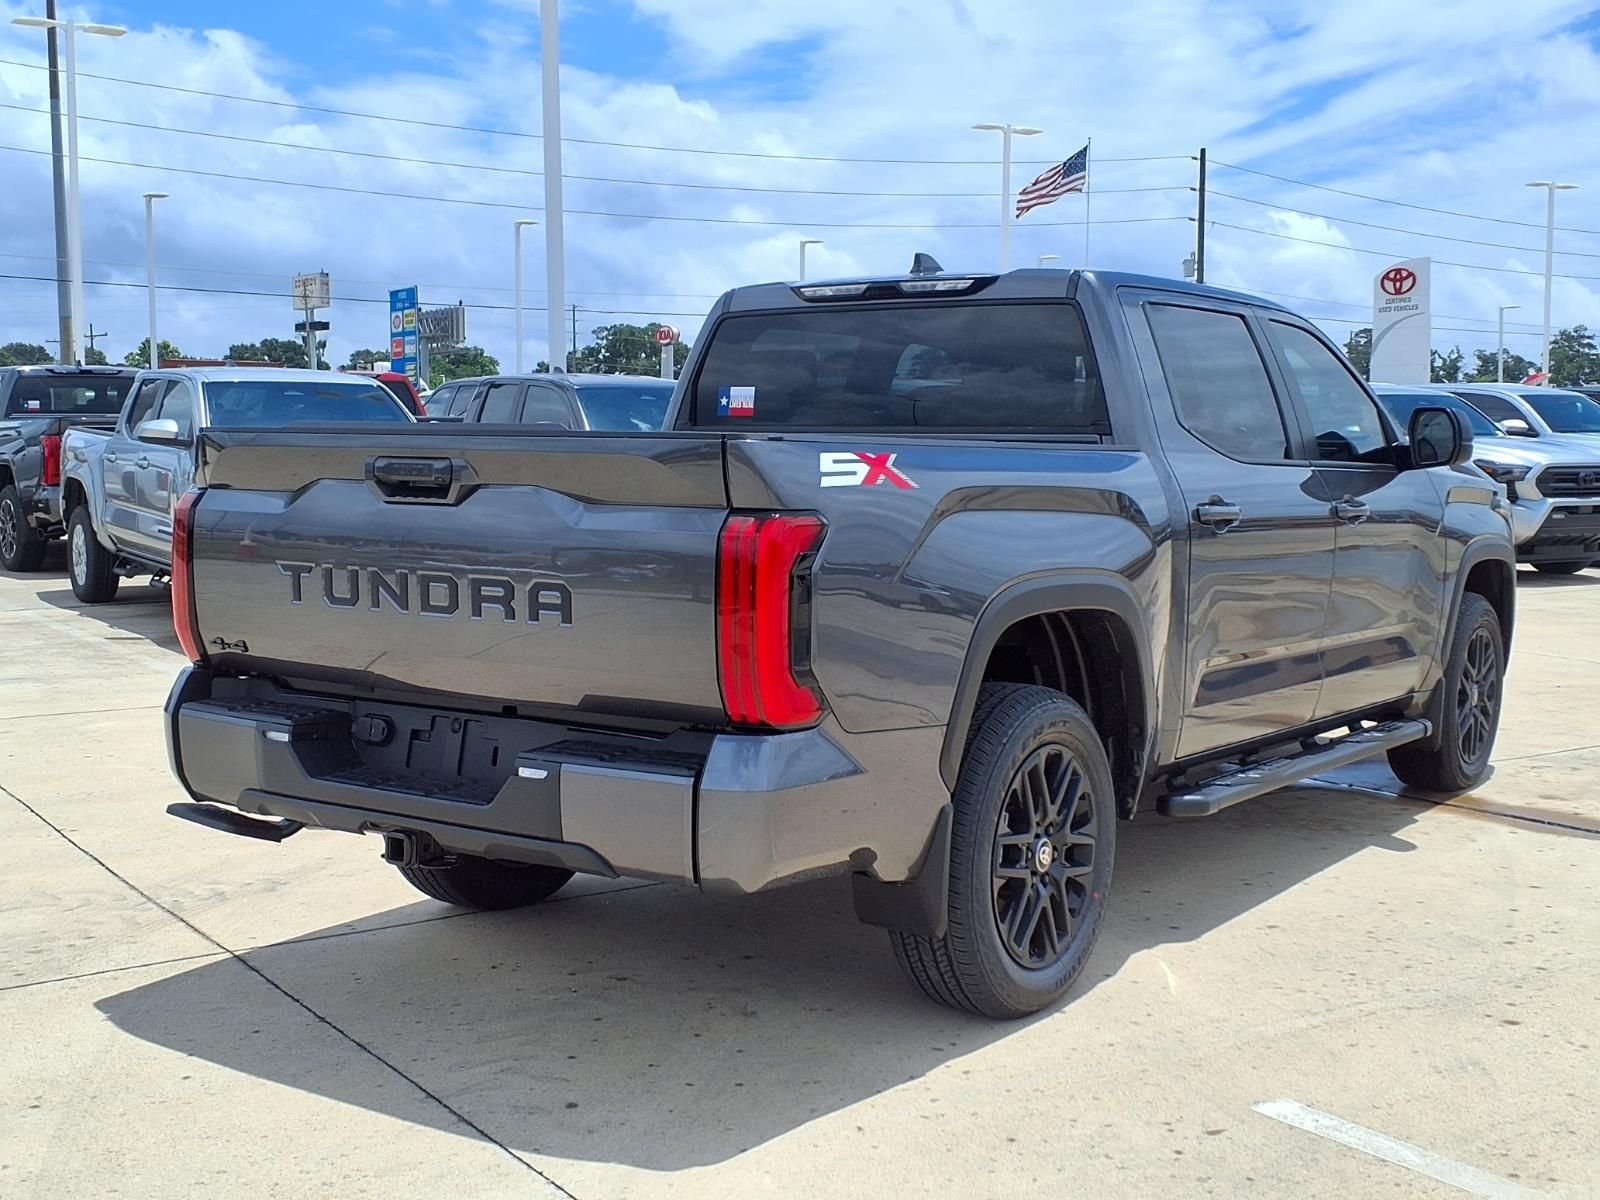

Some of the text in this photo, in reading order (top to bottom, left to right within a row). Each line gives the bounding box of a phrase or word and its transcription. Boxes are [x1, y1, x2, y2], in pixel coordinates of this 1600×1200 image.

[1385, 297, 1411, 305] CERTIFIED
[1393, 304, 1419, 312] VEHICLES
[275, 560, 573, 628] TUNDRA
